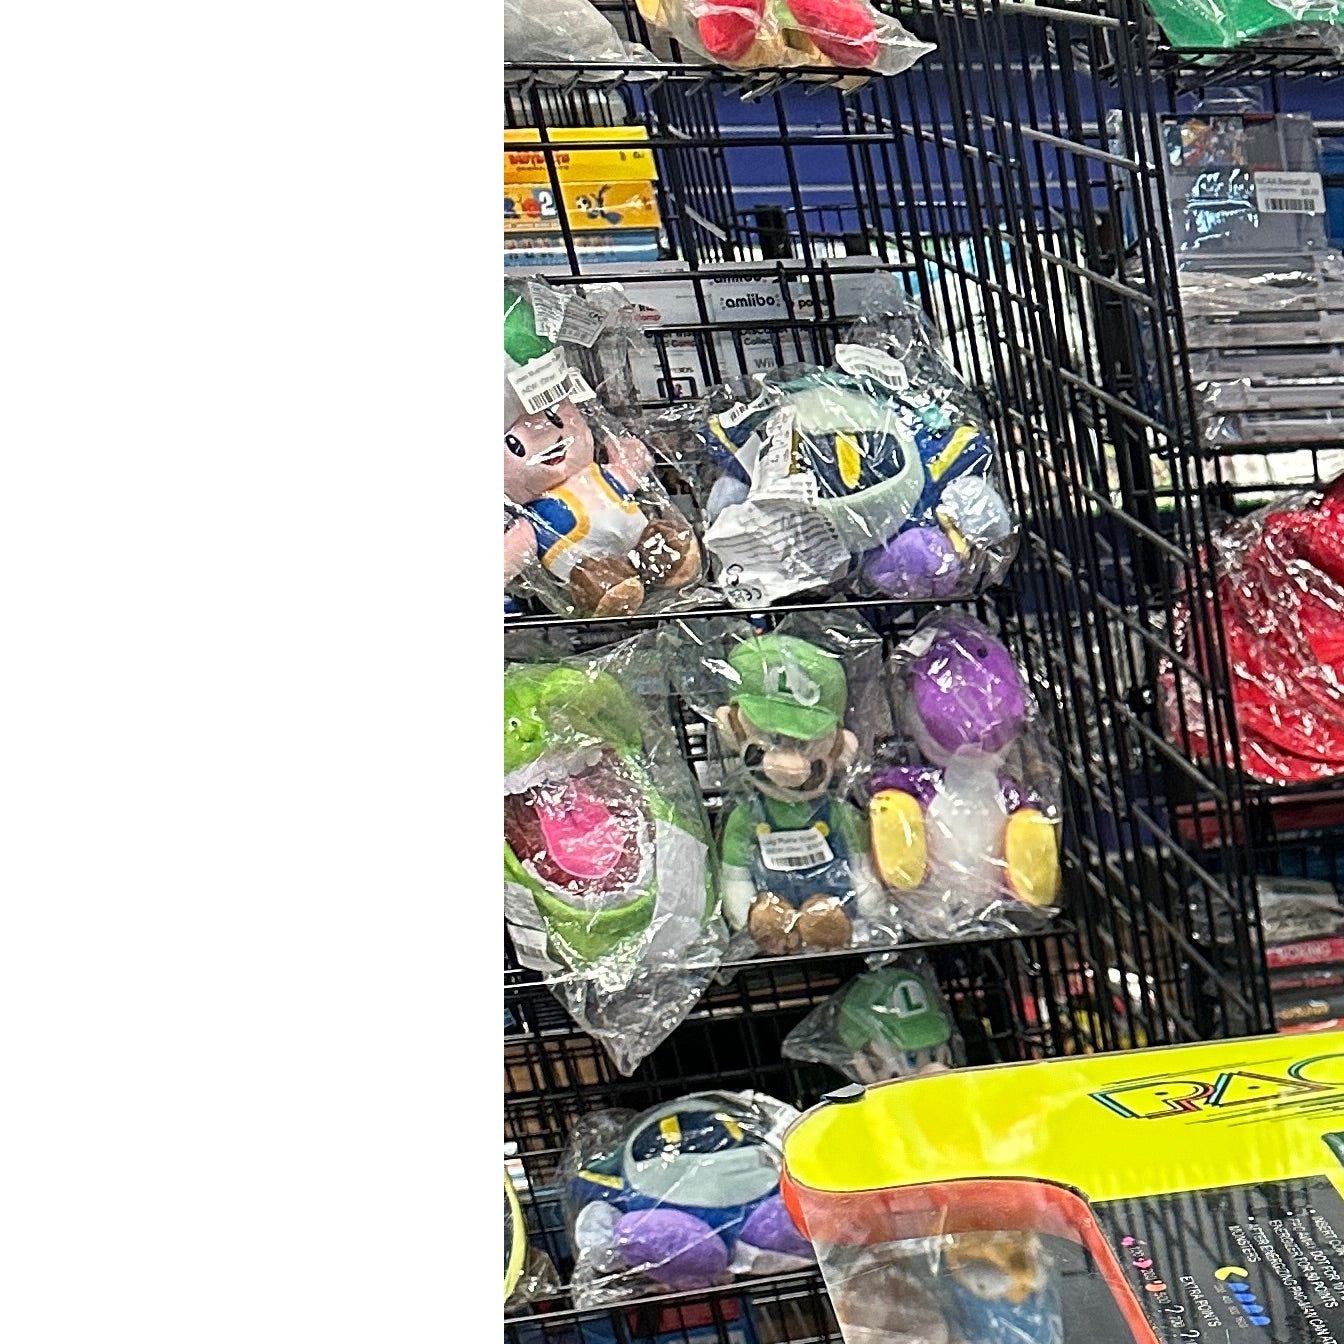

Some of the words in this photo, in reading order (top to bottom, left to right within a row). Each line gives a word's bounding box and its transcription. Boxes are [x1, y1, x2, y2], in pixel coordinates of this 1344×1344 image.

[725, 293, 775, 308] amiibo
[901, 985, 923, 1011] L
[1308, 1249, 1330, 1265] DOT
[1319, 1265, 1341, 1281] FOR
[1293, 1256, 1315, 1272] FOR
[1308, 1280, 1340, 1308] POINTS
[1178, 1275, 1206, 1300] EXTRA
[1193, 1299, 1223, 1327] POINTS
[1307, 1318, 1331, 1335] CAN
